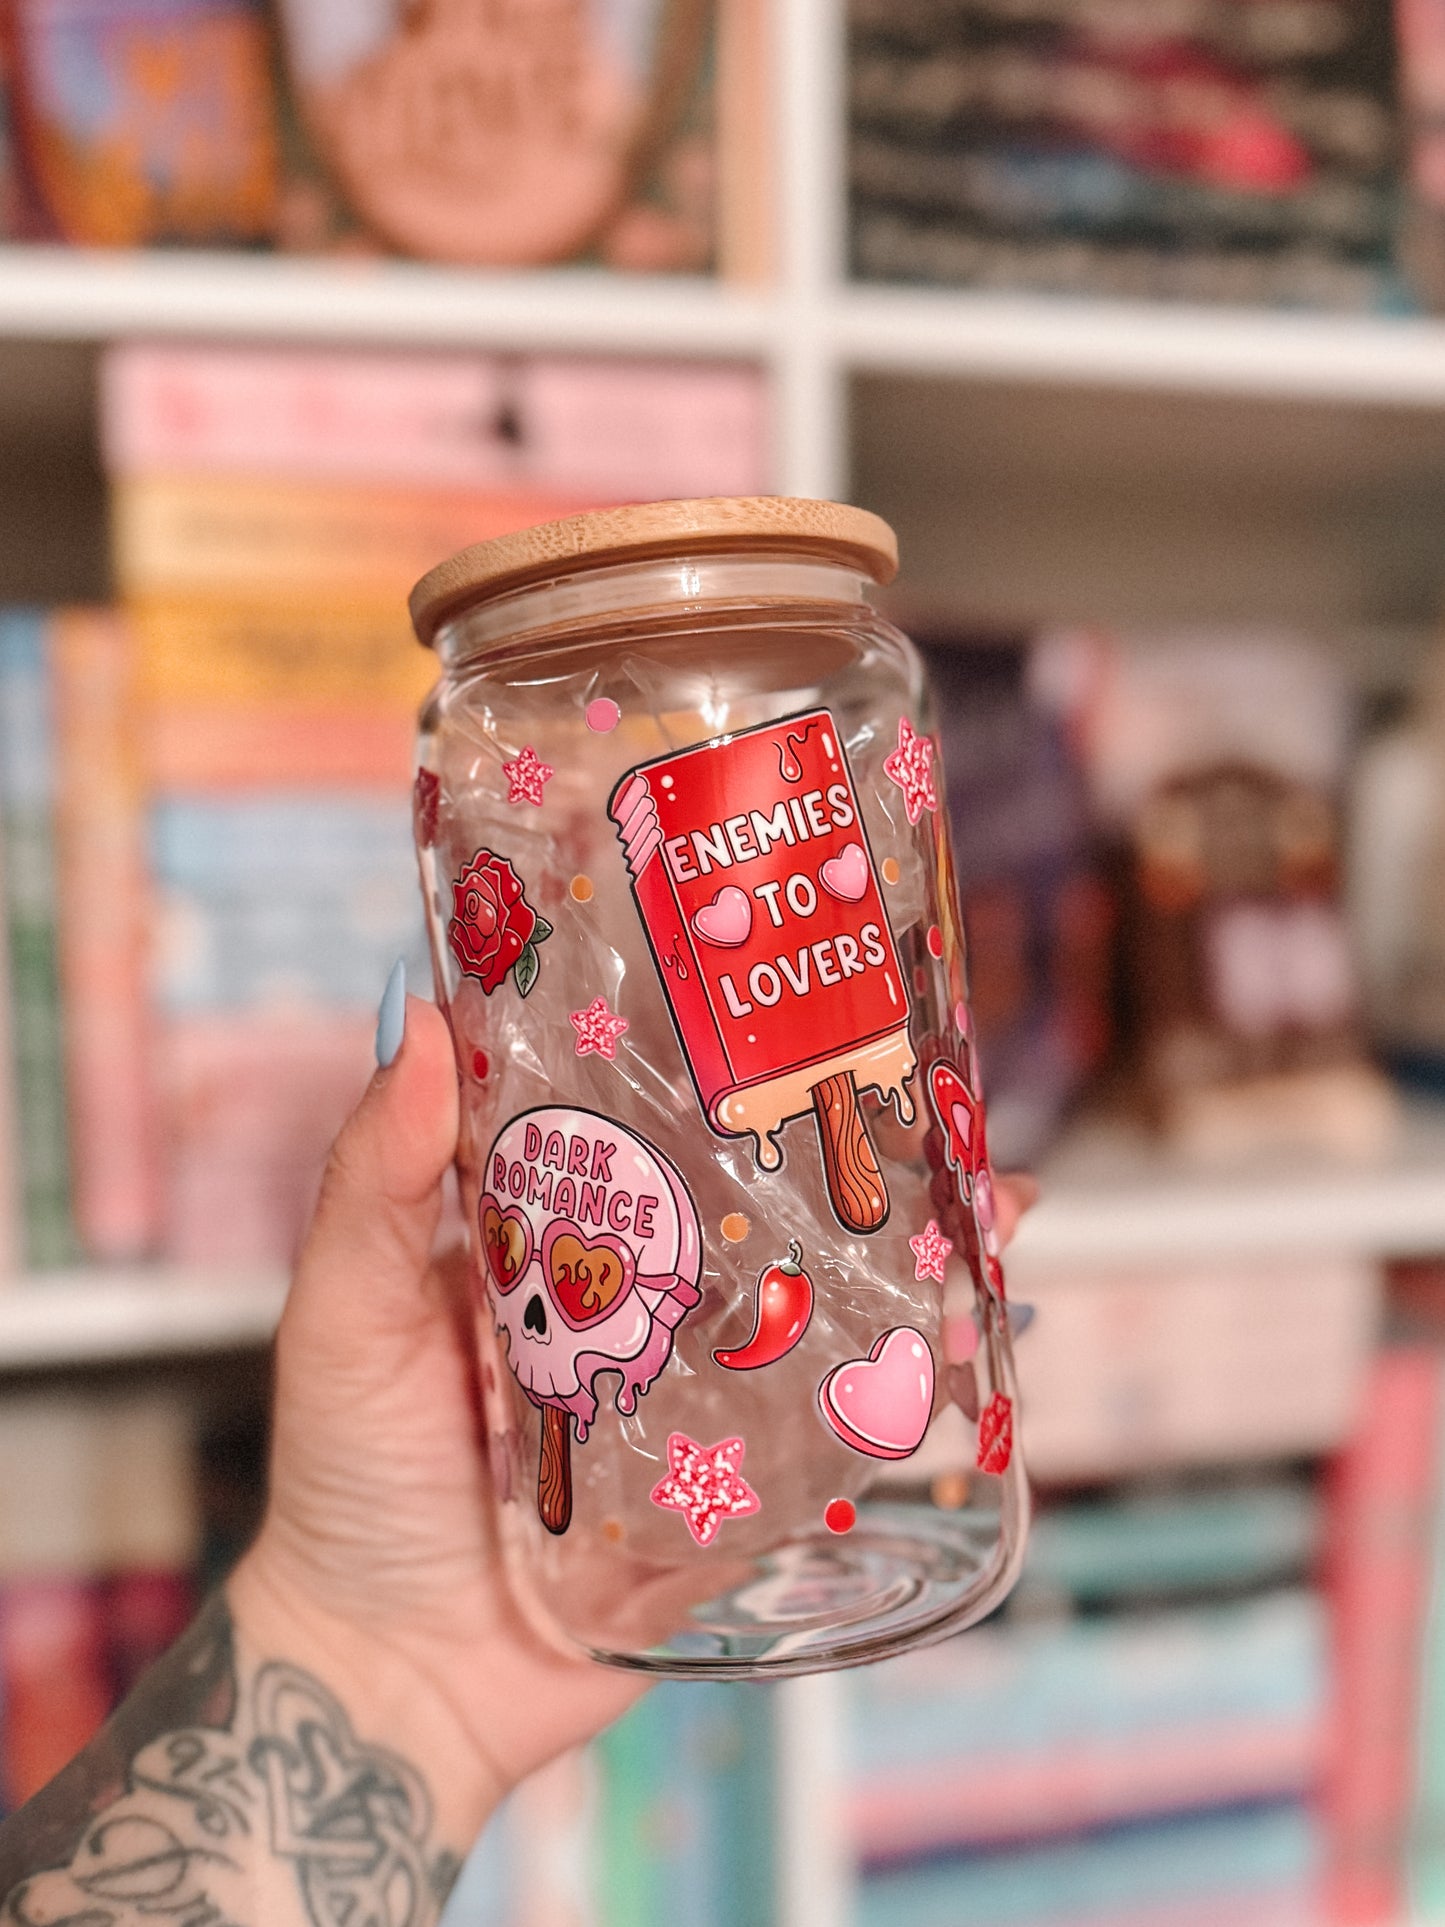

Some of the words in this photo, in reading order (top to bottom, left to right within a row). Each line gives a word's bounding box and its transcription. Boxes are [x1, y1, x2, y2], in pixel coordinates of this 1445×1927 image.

[663, 784, 853, 884] ENEMIES
[753, 873, 817, 927] TO
[718, 922, 886, 1018] LOVERS
[524, 1123, 617, 1182] DARK
[493, 1153, 658, 1239] ROMANCE
